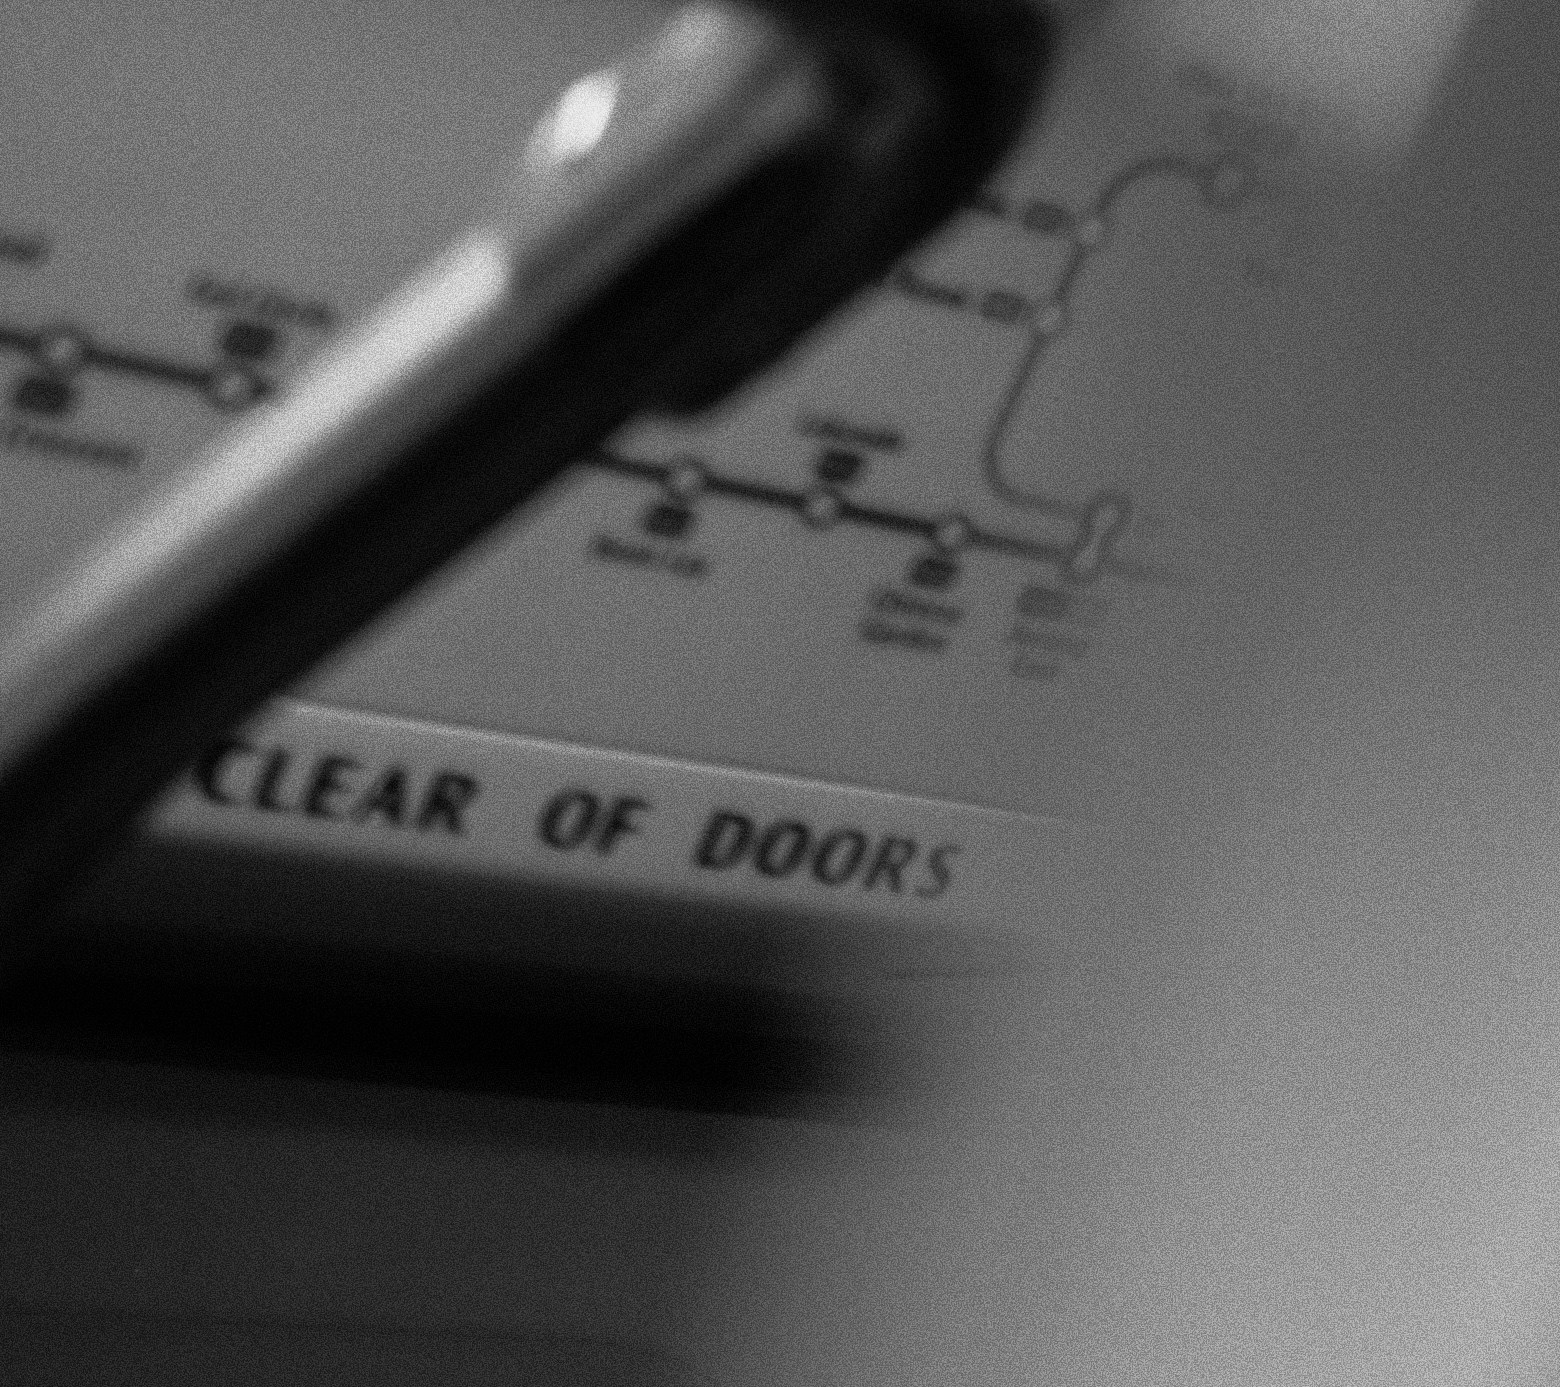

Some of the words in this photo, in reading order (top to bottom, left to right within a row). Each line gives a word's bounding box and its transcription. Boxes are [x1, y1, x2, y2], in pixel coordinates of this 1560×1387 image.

[201, 741, 480, 836] CLEAR
[536, 786, 650, 858] OF
[692, 809, 962, 900] DOORS
